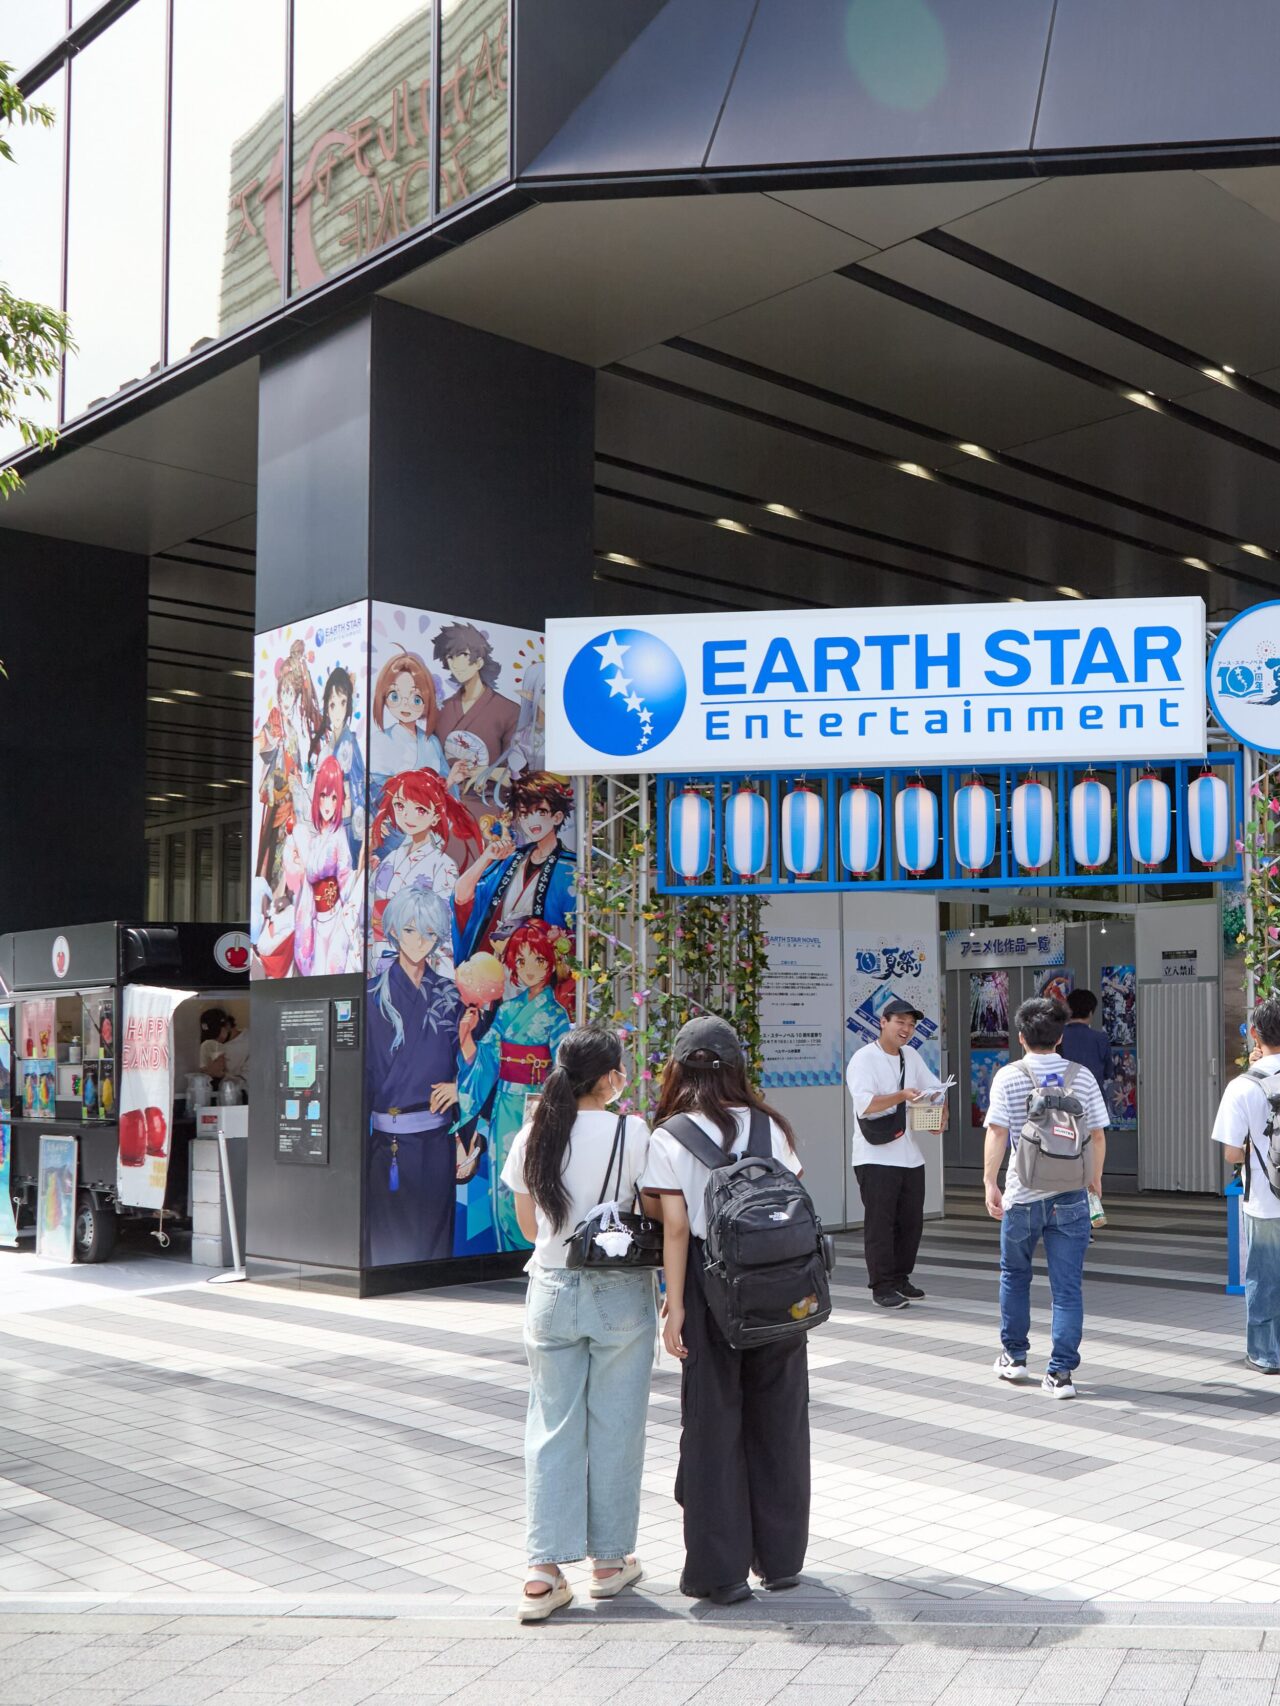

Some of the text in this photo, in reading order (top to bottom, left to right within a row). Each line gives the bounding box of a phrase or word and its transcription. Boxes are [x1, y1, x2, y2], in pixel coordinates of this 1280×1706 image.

[325, 618, 362, 637] EARTH STAR
[702, 626, 1181, 695] EARTH STAR
[706, 698, 1179, 740] Entertainment
[960, 936, 1050, 954] アニメ化作品一覧
[876, 947, 922, 980] 夏祭り
[1162, 965, 1197, 976] 立入禁止
